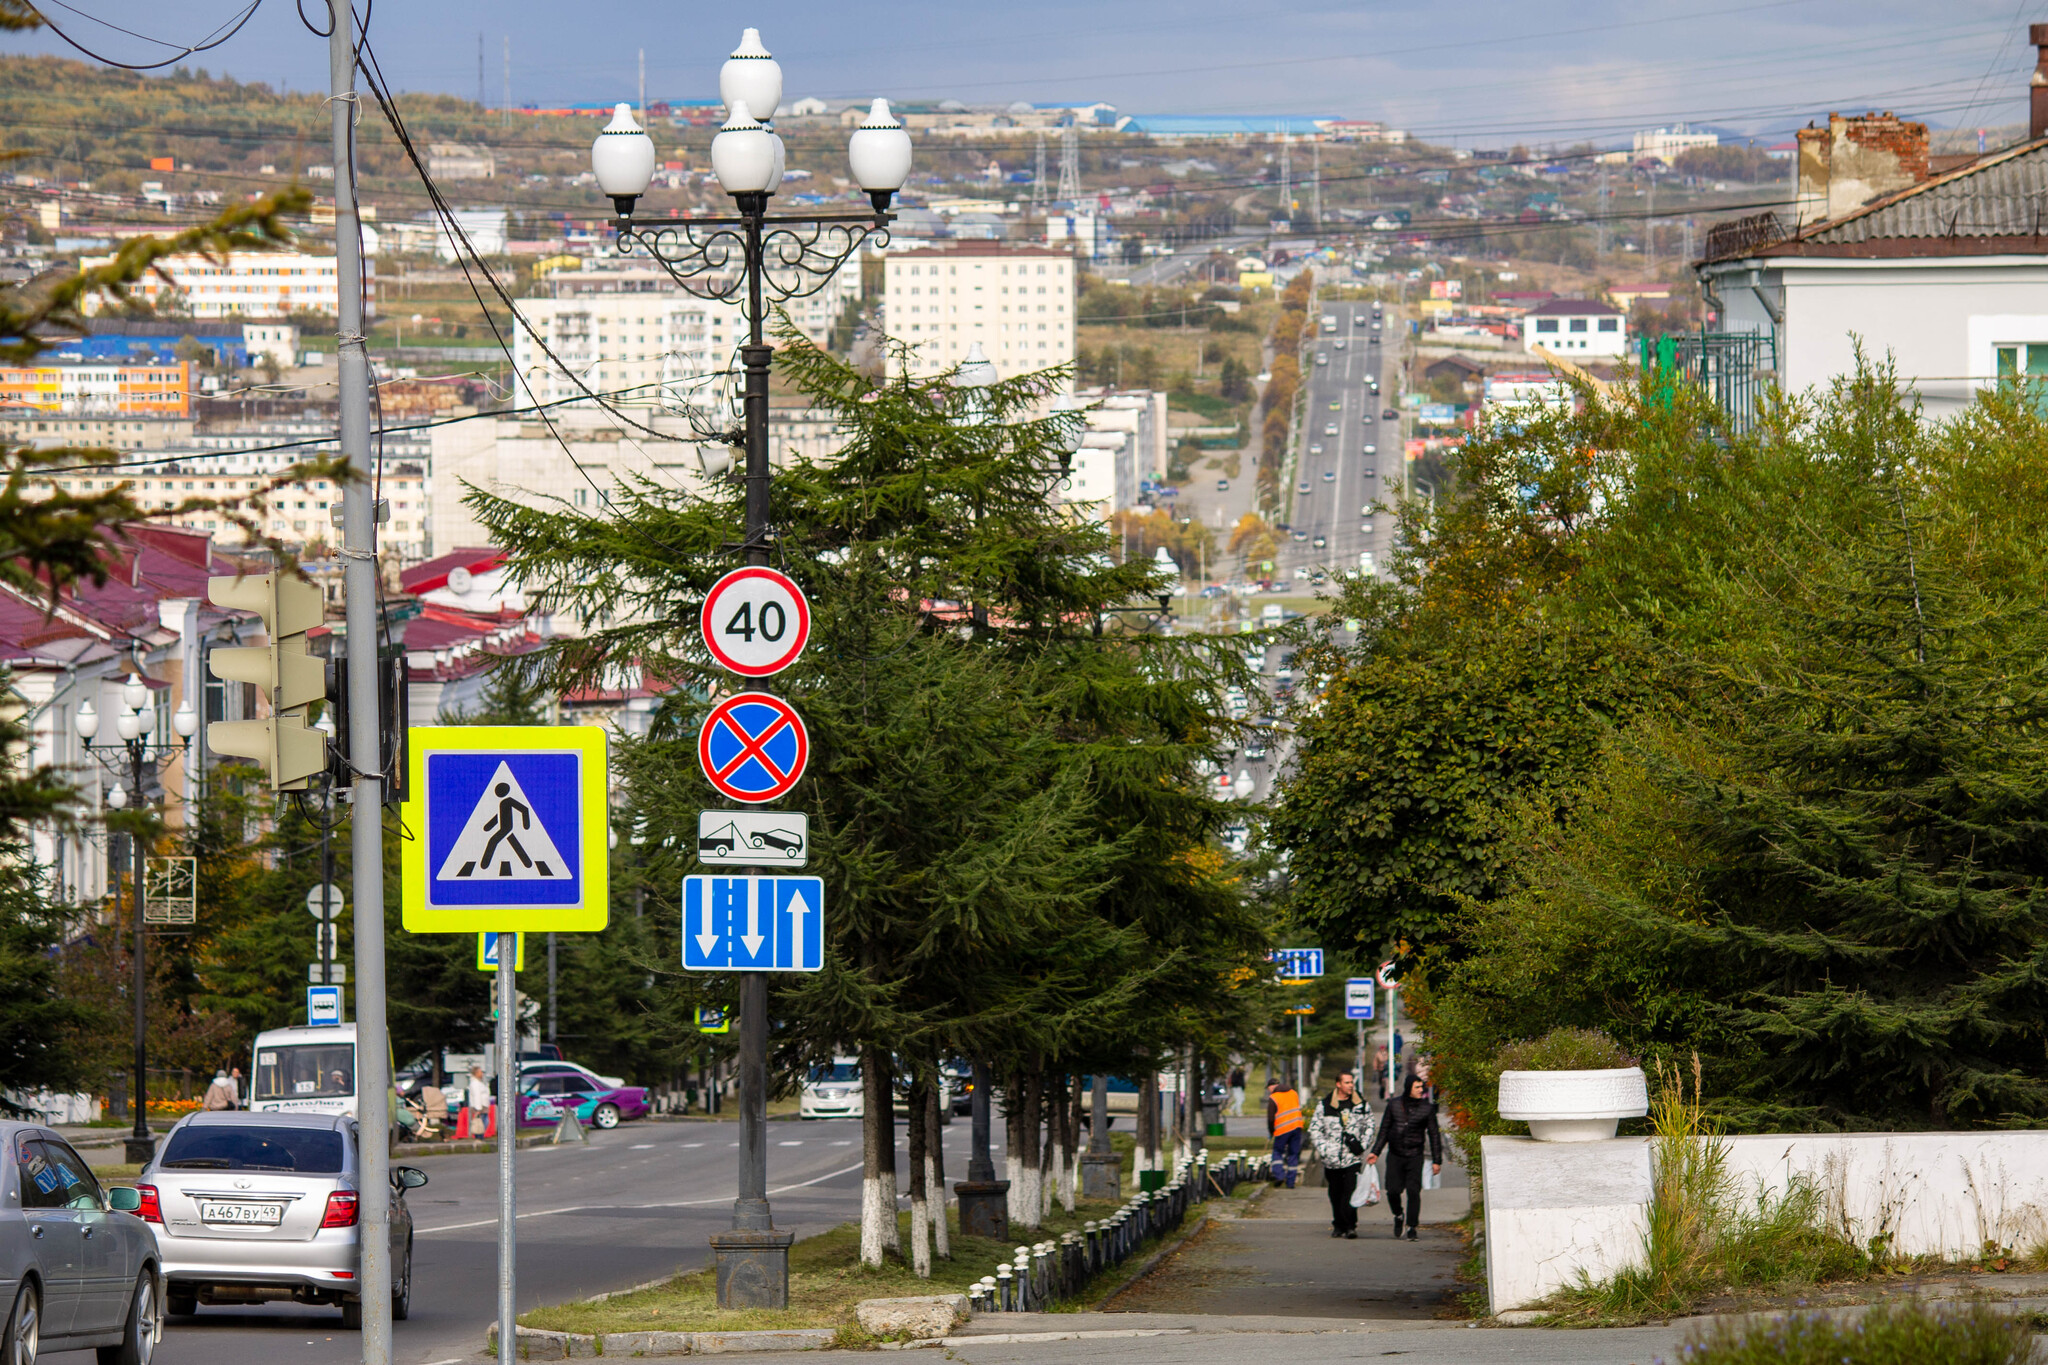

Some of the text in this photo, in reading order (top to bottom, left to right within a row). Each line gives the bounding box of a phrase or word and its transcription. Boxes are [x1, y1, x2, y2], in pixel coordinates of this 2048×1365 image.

[725, 600, 786, 642] 40
[300, 1082, 312, 1091] 15
[263, 1207, 276, 1217] 49
